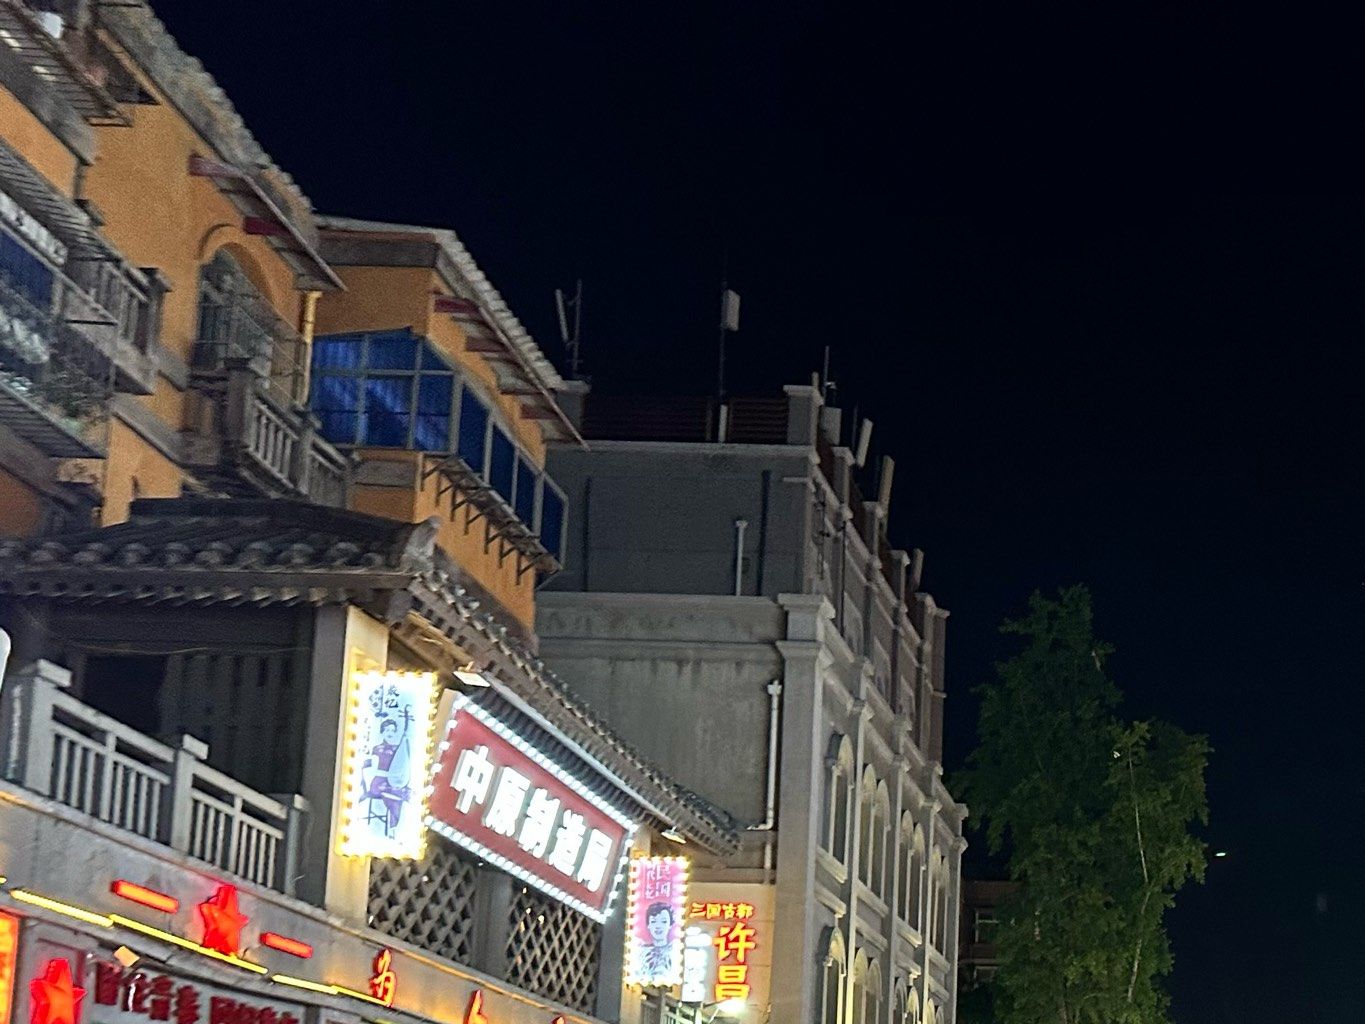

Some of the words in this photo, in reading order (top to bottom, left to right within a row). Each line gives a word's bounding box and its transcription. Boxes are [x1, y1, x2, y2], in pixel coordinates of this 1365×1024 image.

[451, 745, 613, 892] 中原制造局
[690, 902, 754, 919] 三国古都
[713, 922, 757, 1002] 许昌
